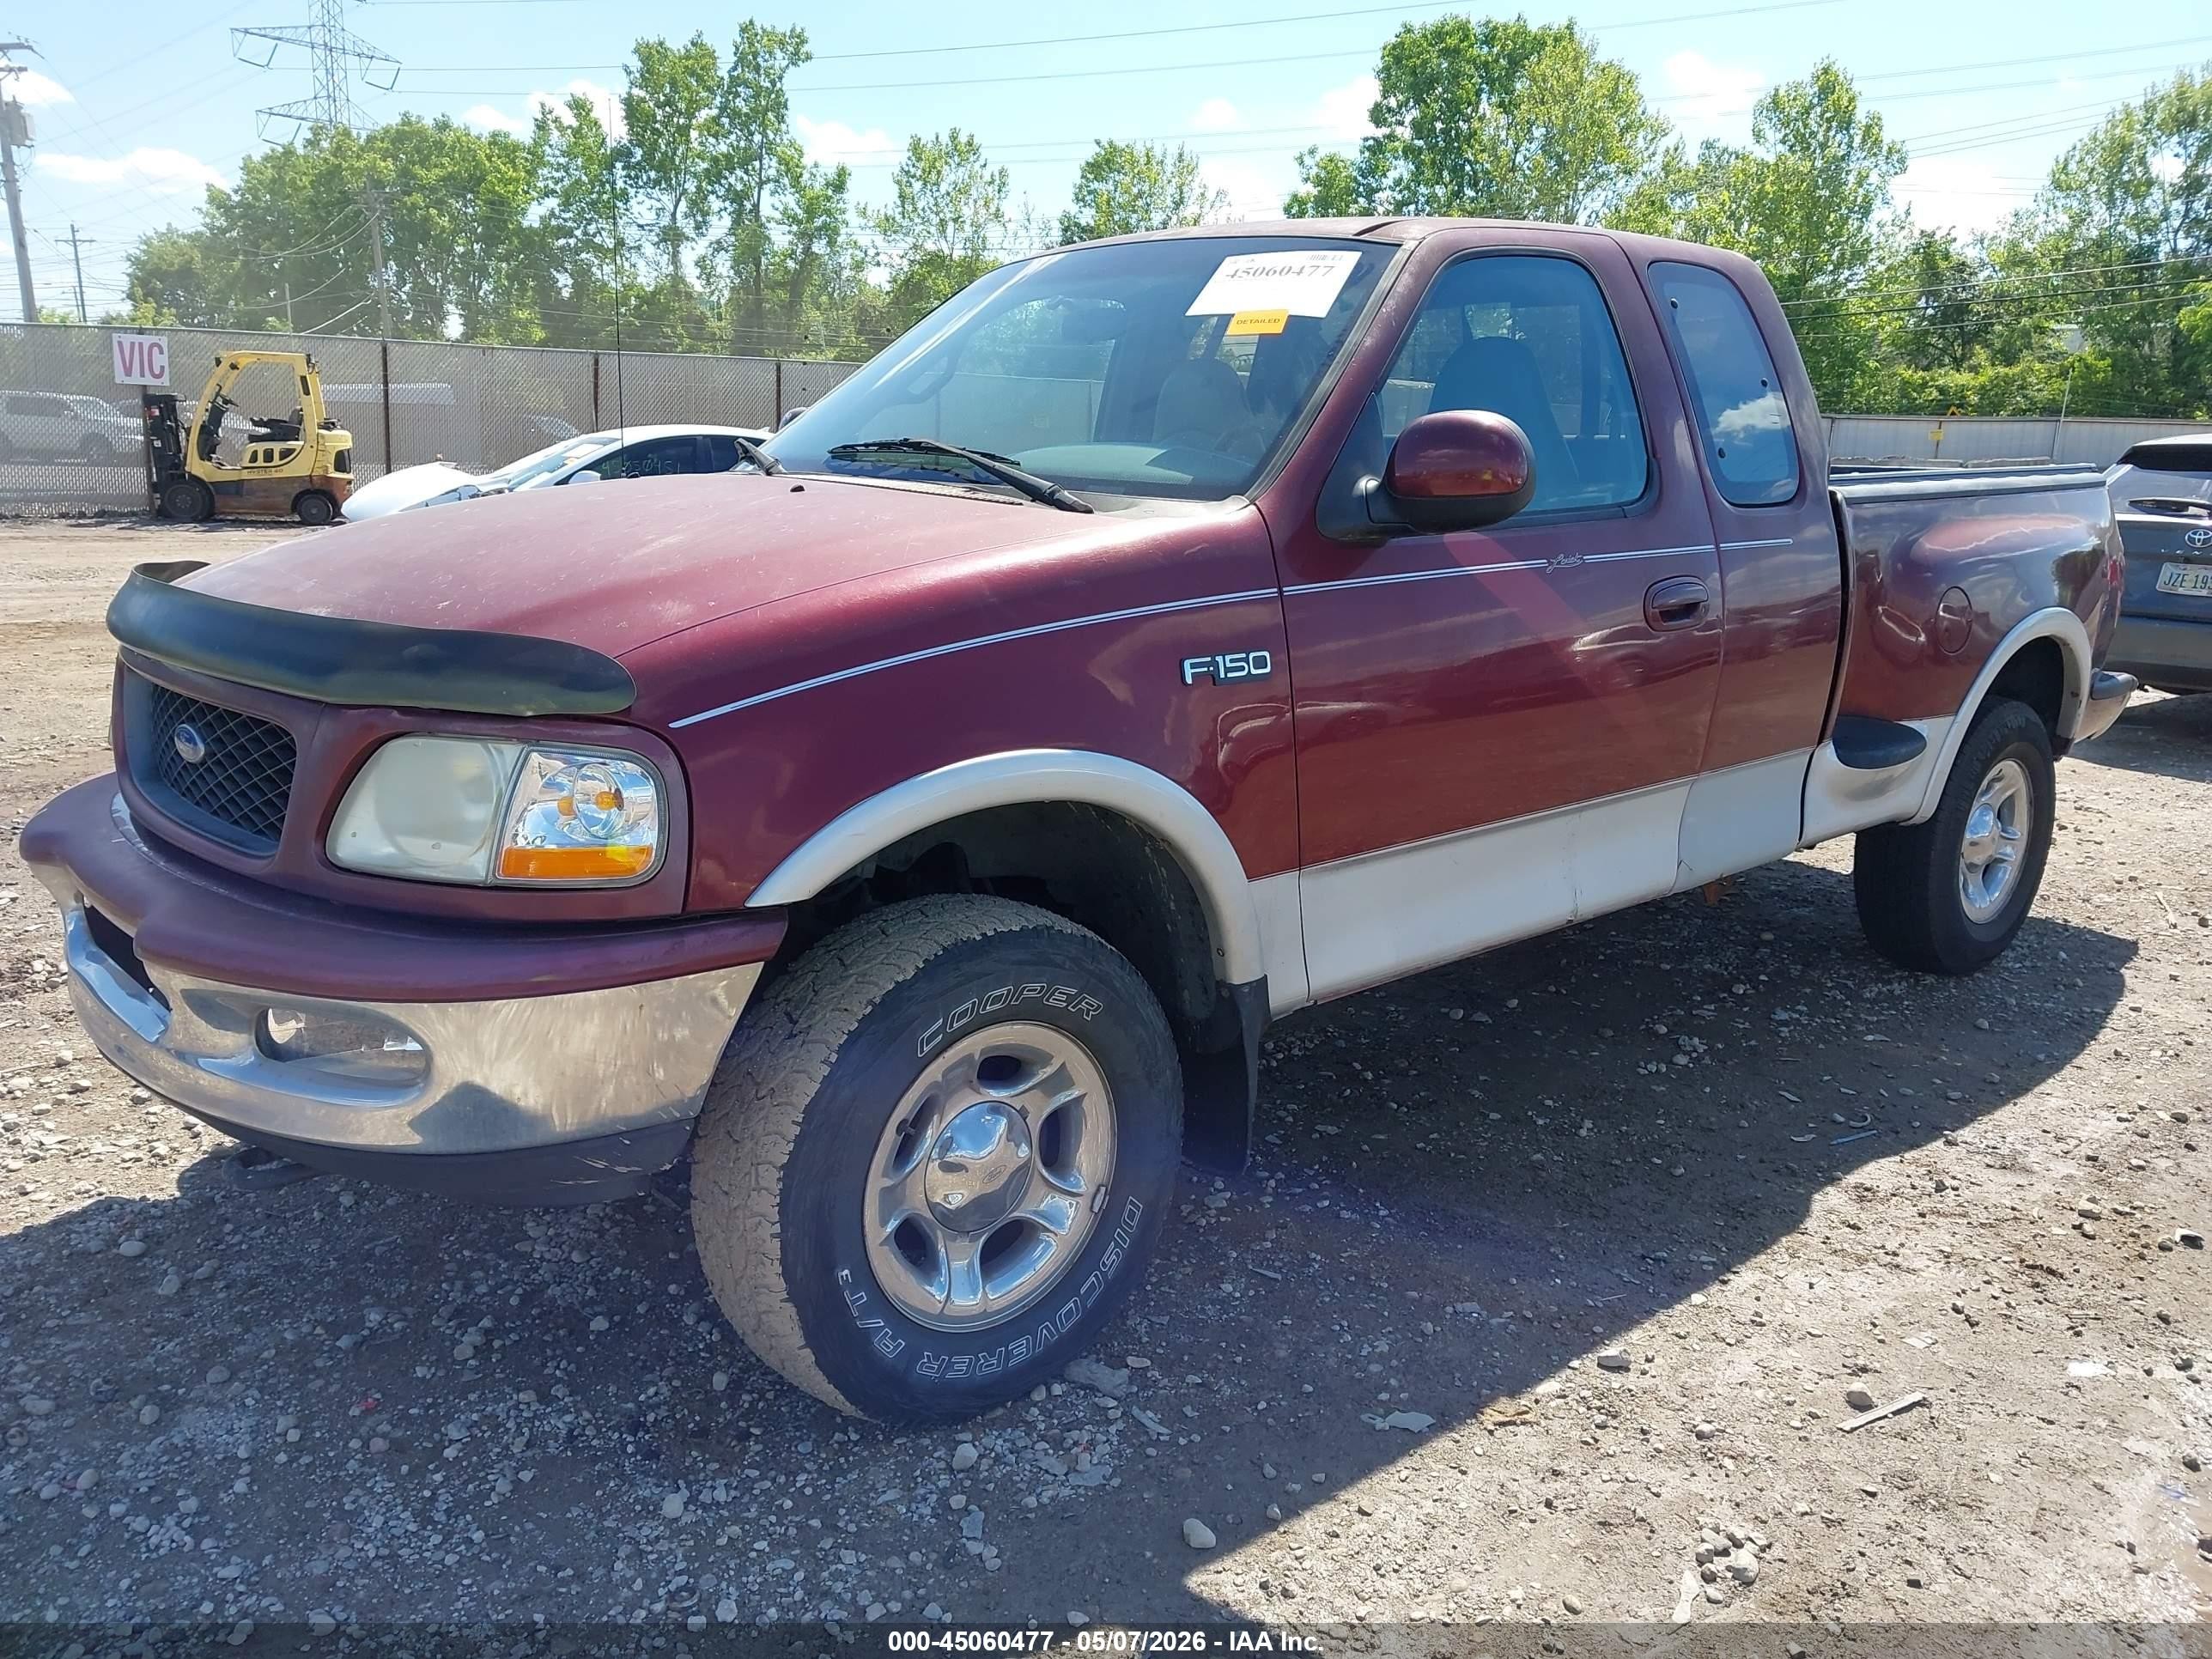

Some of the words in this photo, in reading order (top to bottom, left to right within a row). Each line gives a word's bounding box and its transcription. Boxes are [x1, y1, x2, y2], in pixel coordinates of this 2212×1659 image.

[1225, 265, 1335, 279] 45060477
[117, 340, 165, 379] VIC
[2164, 572, 2189, 588] JZE
[918, 983, 1103, 1057] COOPER
[916, 1195, 1143, 1379] DISCOVERER
